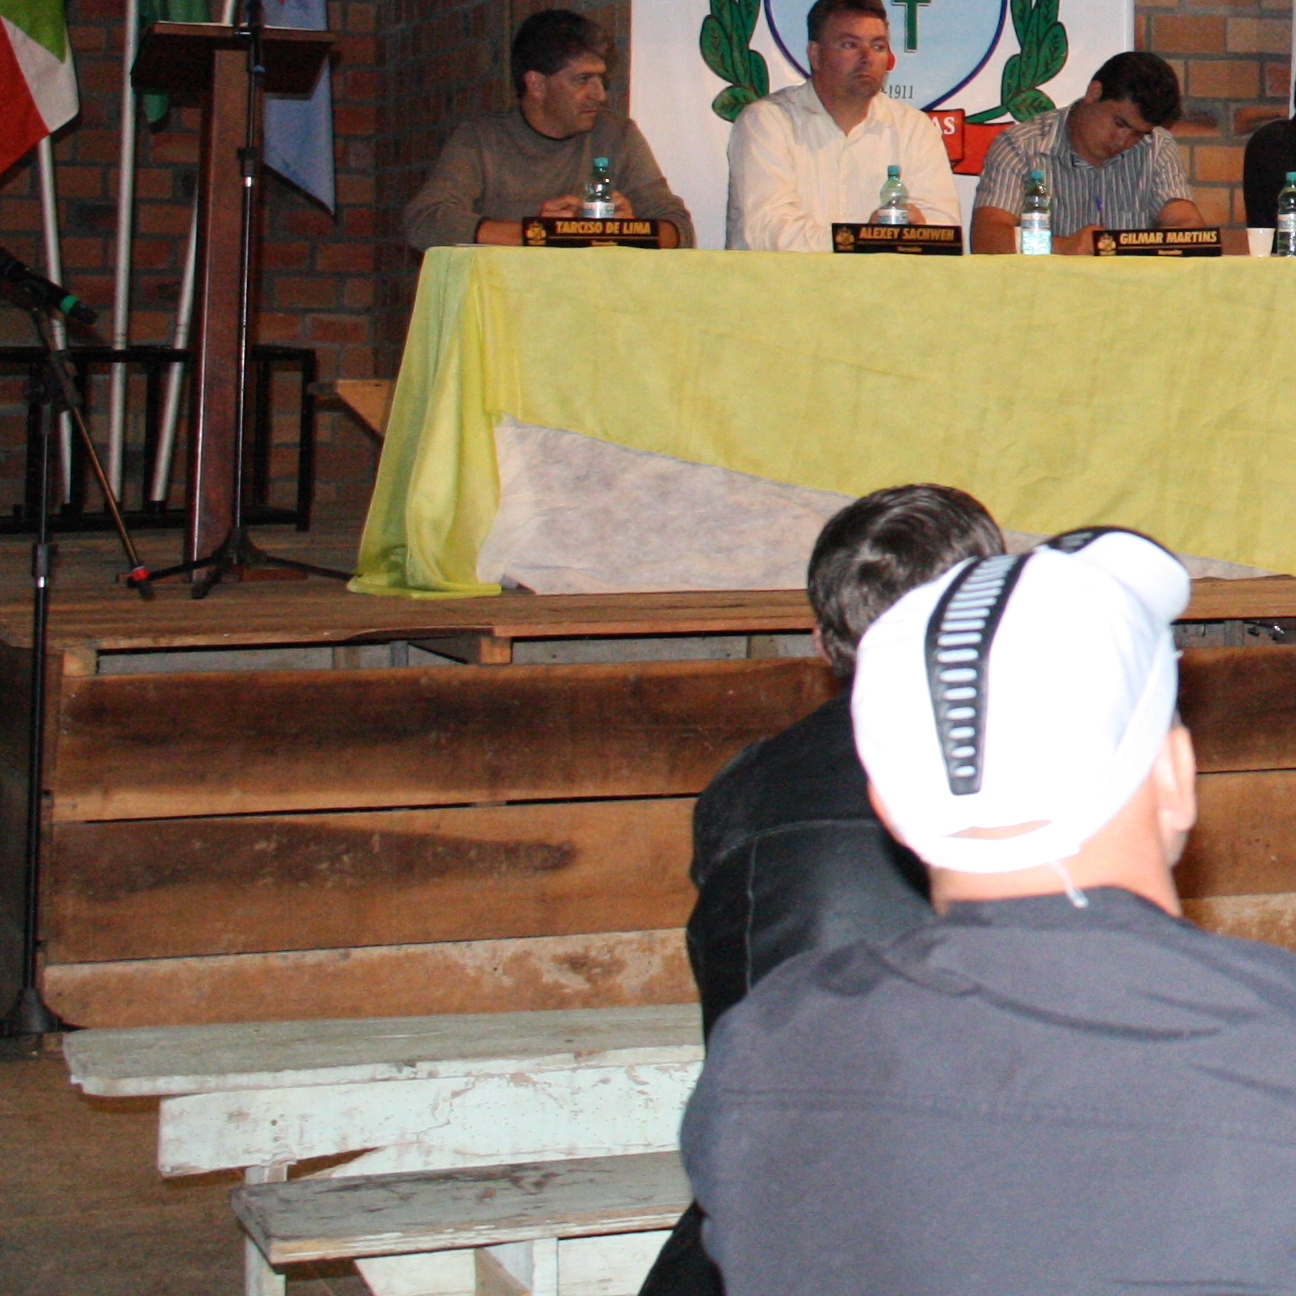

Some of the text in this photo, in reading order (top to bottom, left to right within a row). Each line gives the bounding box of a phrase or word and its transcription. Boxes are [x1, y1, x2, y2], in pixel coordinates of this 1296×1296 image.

[555, 221, 651, 234] TARCISO DE LIMA
[859, 227, 900, 239] ALEXEY
[1166, 231, 1217, 243] MARTINS
